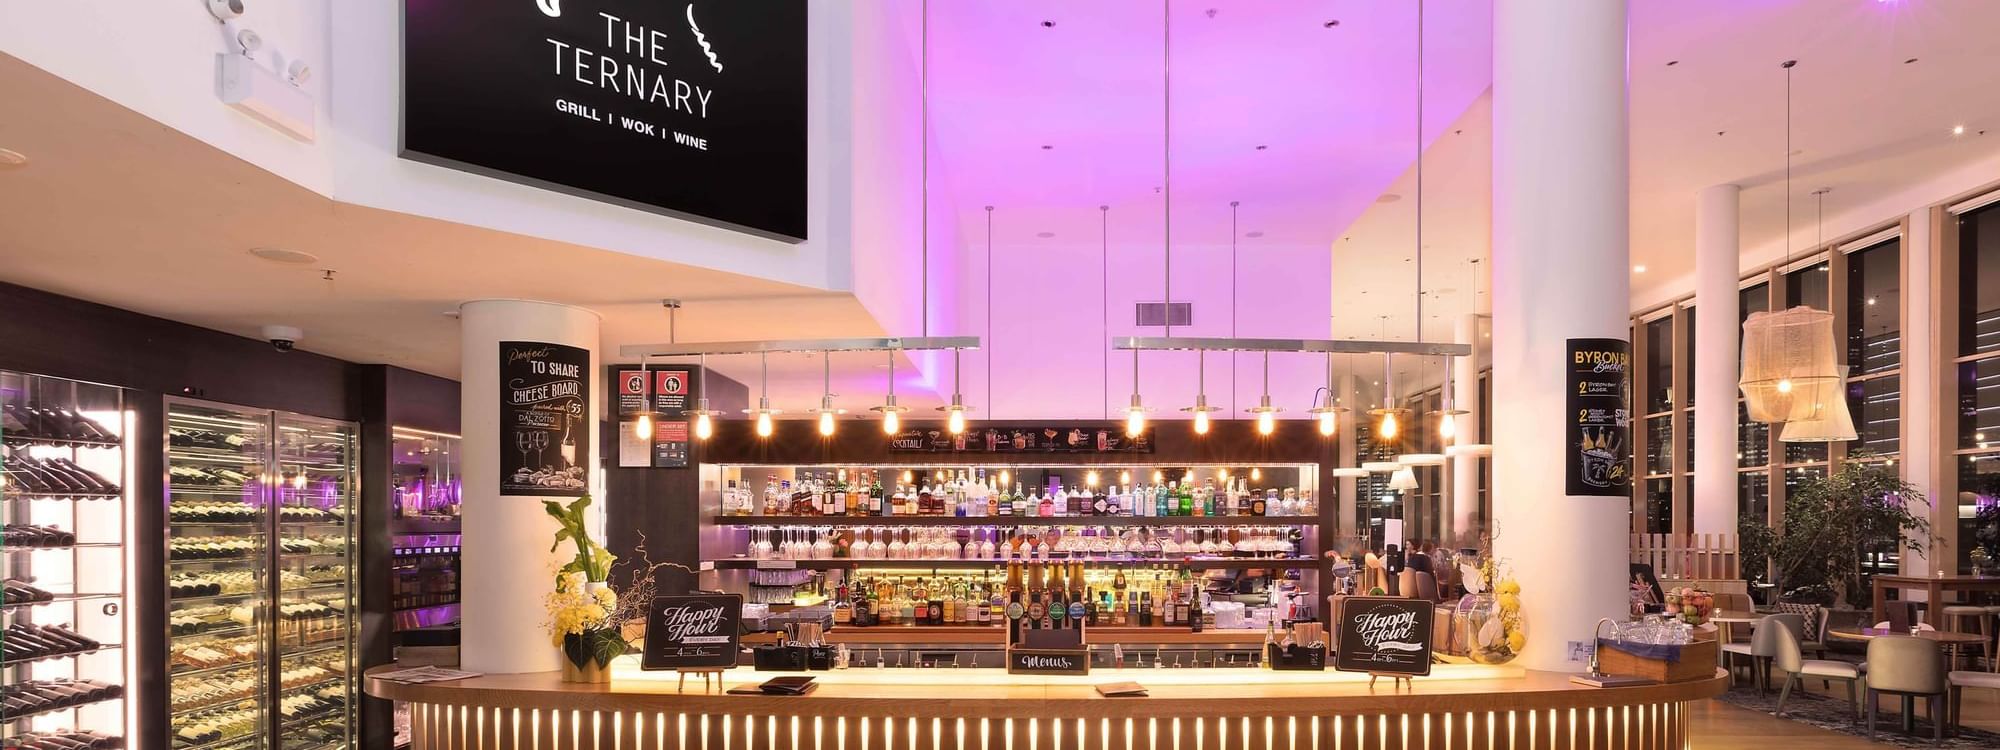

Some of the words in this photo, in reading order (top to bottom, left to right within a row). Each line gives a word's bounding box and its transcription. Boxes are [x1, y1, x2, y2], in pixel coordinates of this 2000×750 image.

[599, 12, 668, 66] THE
[546, 38, 712, 118] TERNARY
[555, 98, 601, 122] GRILL
[621, 116, 655, 137] WOK
[674, 131, 708, 151] WINE
[1575, 351, 1619, 364] BYRON
[530, 360, 546, 374] TO
[549, 362, 579, 378] SHARE
[513, 385, 549, 403] CHEESE
[551, 382, 578, 397] BOARD
[1579, 381, 1587, 394] 2
[1579, 409, 1588, 423] 2
[892, 438, 923, 449] COCKTAILS
[664, 606, 728, 626] Happy
[1354, 611, 1419, 633] Happy
[668, 621, 718, 641] Hour
[1362, 627, 1411, 647] Hour
[1022, 655, 1072, 669] Menus
